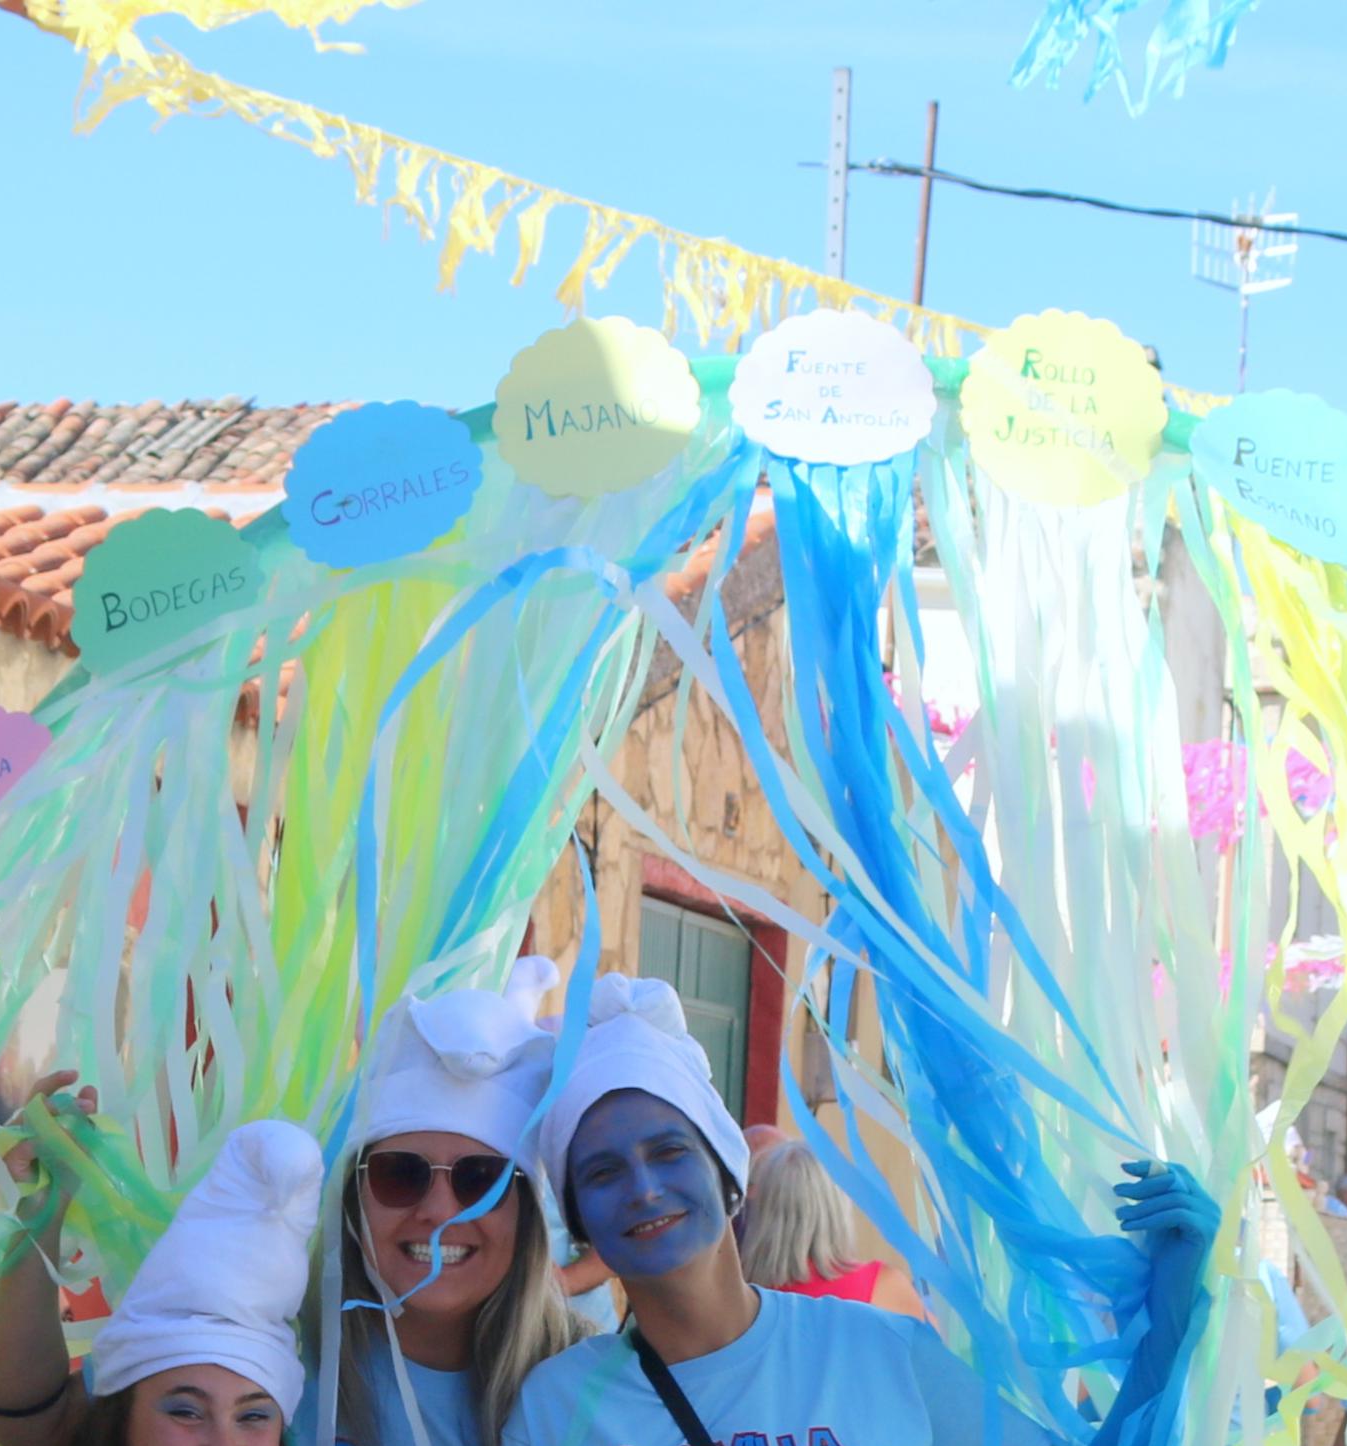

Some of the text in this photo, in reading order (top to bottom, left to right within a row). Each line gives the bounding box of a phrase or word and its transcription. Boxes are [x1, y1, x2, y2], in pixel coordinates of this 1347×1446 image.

[785, 350, 867, 375] FUENTE
[1021, 348, 1096, 386] ROLLO
[819, 385, 842, 398] DE
[1028, 388, 1098, 414] DE LA
[524, 399, 659, 441] MAJANO
[764, 399, 909, 427] SAN ANTOLÍN
[994, 415, 1115, 451] JUSTICIA
[1233, 437, 1335, 483] PUENTE
[311, 460, 469, 526] CORRALES
[101, 566, 245, 632] BODEGAS
